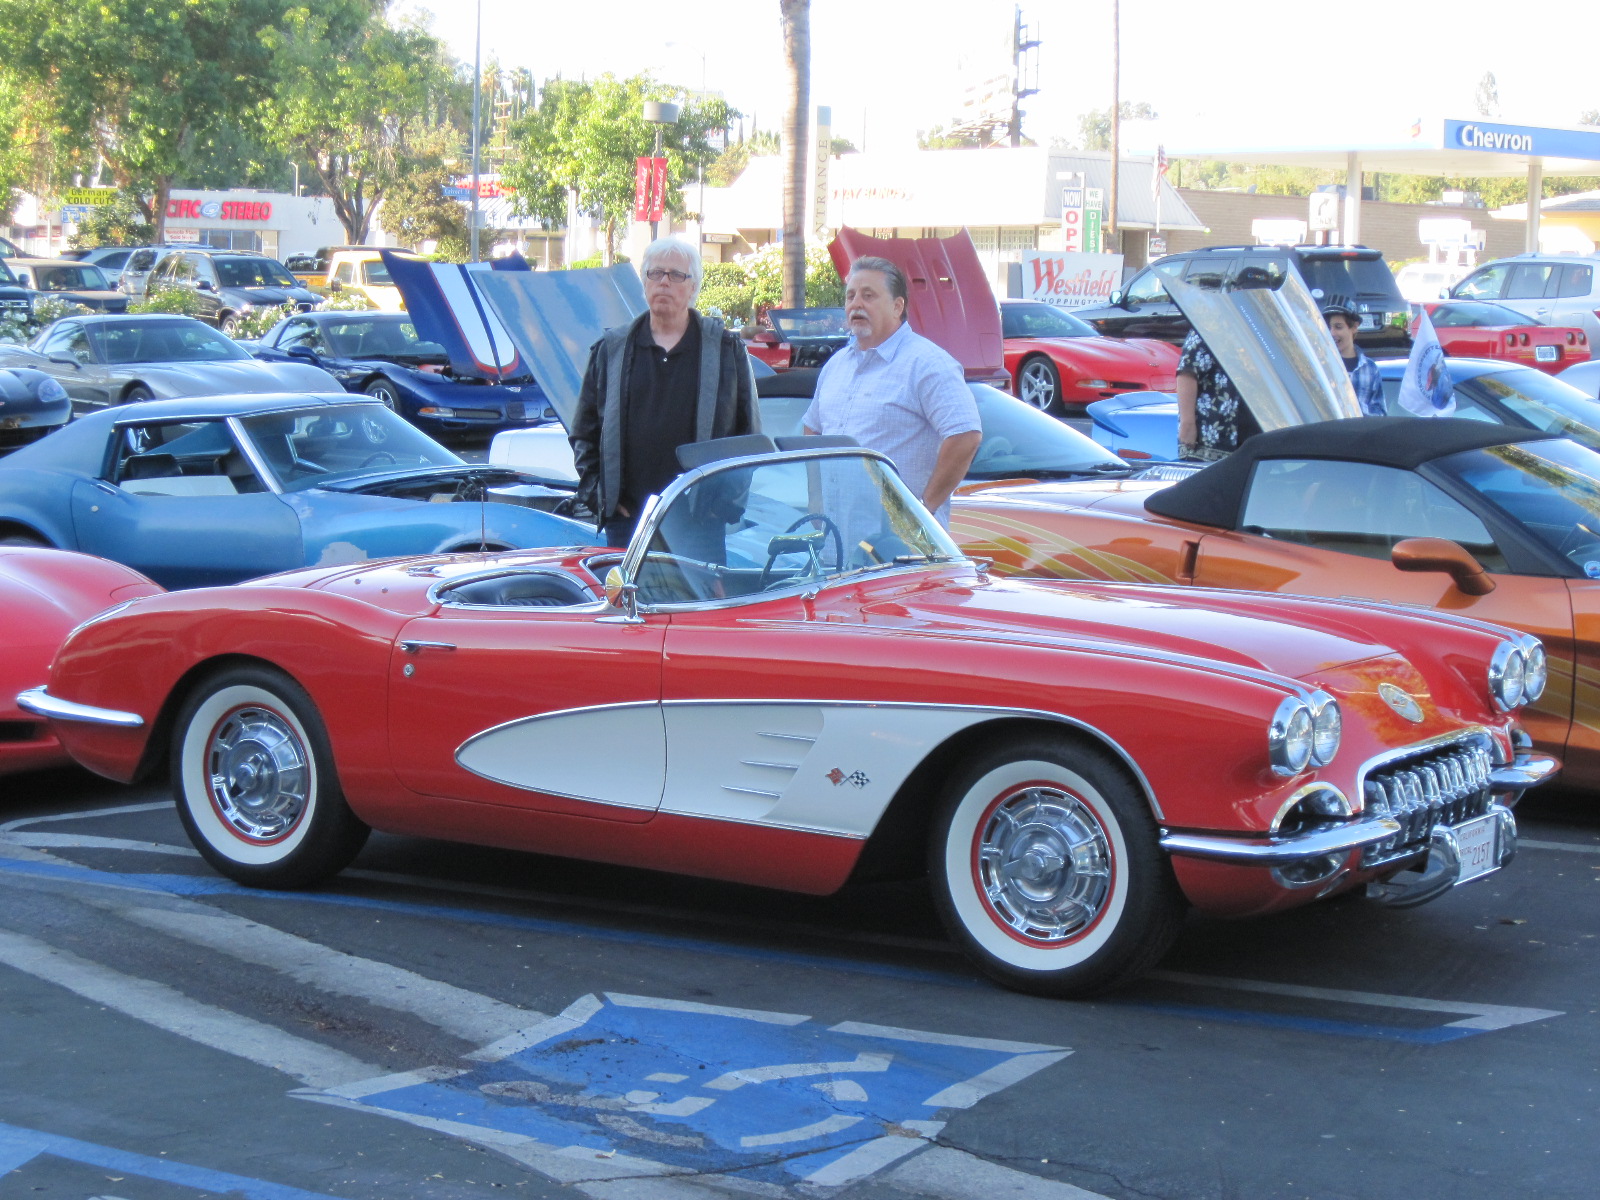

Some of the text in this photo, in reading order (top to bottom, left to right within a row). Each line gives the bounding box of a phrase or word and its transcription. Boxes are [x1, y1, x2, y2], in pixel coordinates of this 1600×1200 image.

[1461, 124, 1532, 151] Chevron
[815, 139, 828, 233] NTRANCE
[1089, 190, 1099, 198] WE
[149, 199, 273, 221] CIFIC STEREO
[1064, 190, 1082, 207] NOW
[1085, 201, 1101, 209] HAVE
[1029, 257, 1119, 297] Westfield
[1471, 841, 1491, 866] 2157
